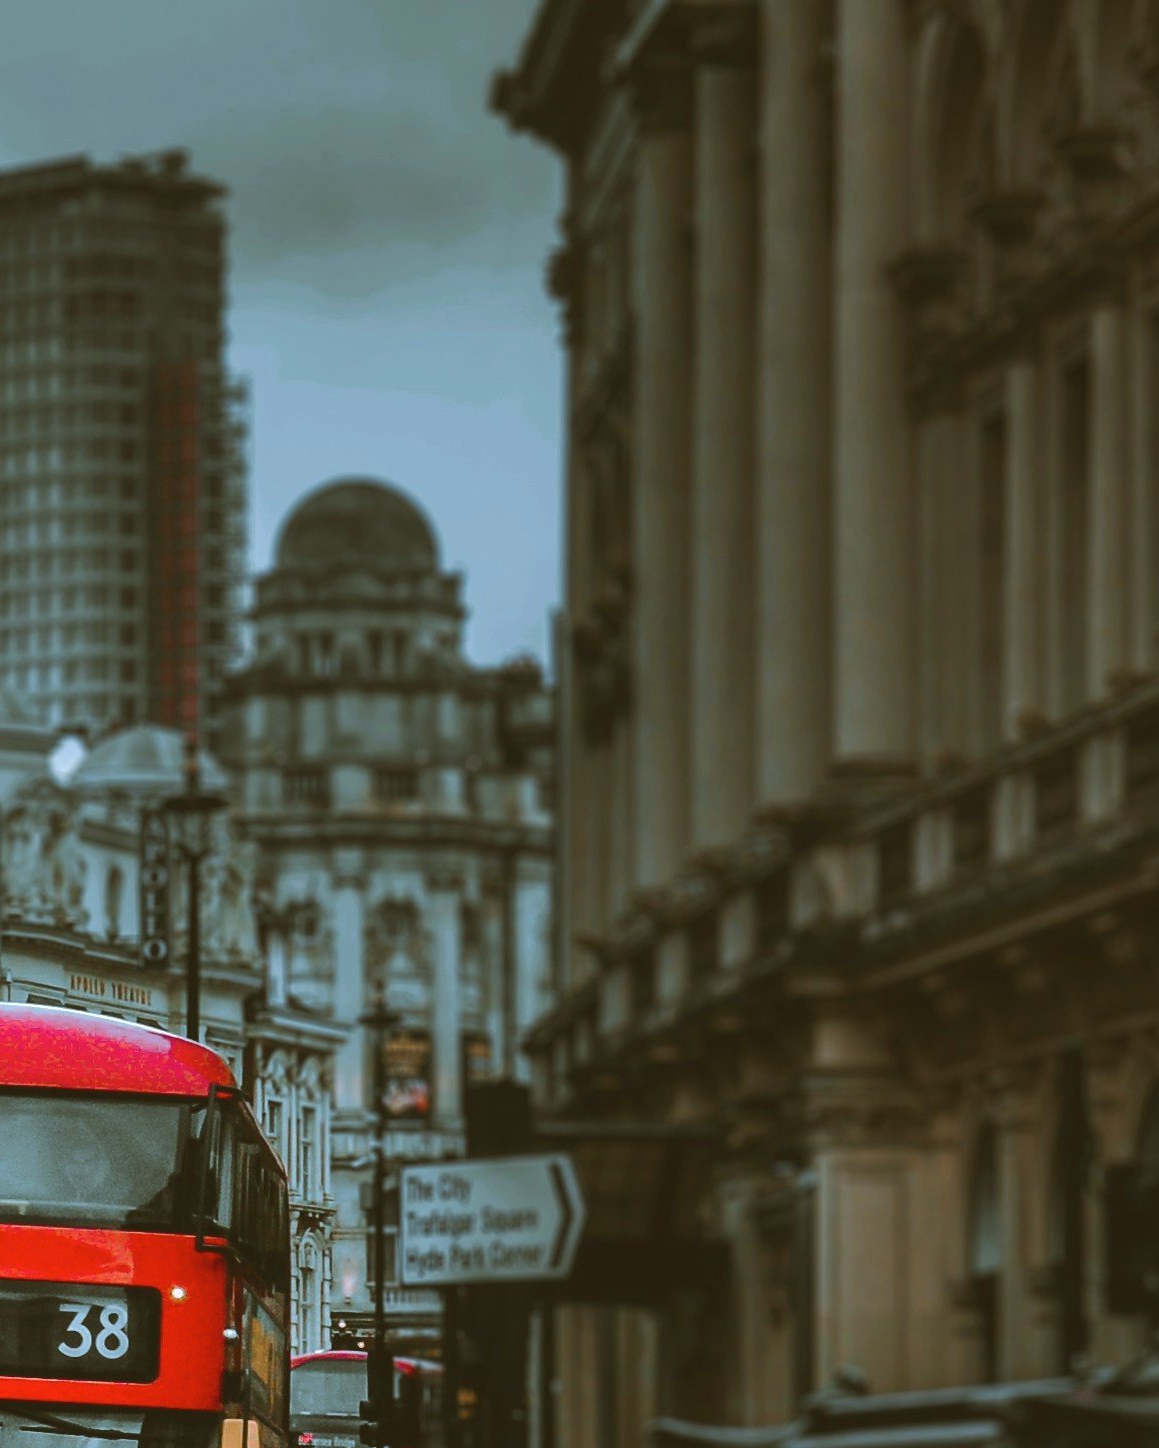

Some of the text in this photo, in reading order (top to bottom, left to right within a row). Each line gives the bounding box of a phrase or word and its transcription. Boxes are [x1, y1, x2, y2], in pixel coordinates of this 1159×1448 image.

[407, 1173, 471, 1204] The City
[407, 1205, 538, 1239] Trafalgar Square
[406, 1240, 542, 1277] Hyde Park Corner
[57, 1303, 129, 1359] 38
